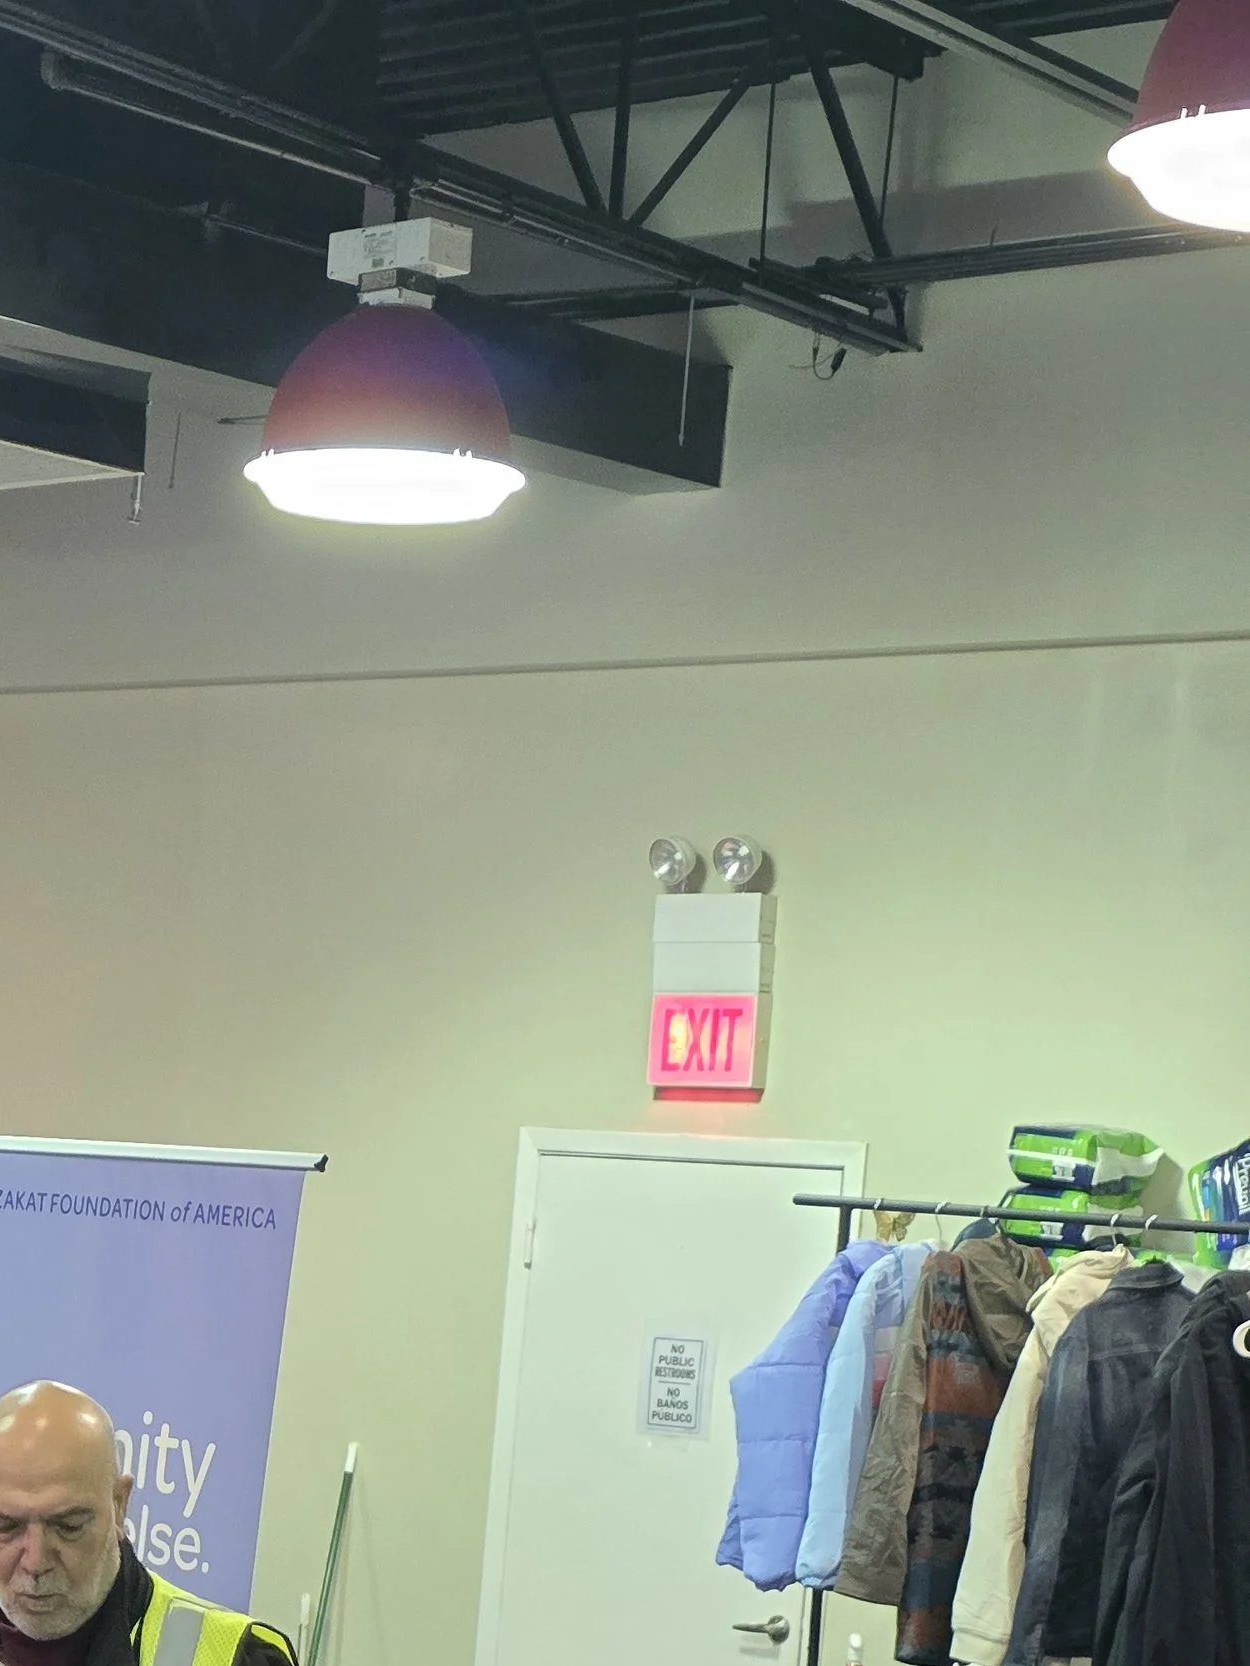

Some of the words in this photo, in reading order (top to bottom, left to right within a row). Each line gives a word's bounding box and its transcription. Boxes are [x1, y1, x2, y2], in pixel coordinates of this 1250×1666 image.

[661, 1008, 743, 1071] EXIT
[50, 1192, 166, 1222] FOUNDATION
[170, 1200, 192, 1223] of
[193, 1202, 276, 1230] AMERICA
[670, 1344, 685, 1354] NO
[658, 1354, 695, 1367] PUBLIC
[654, 1366, 696, 1380] RESTROOMS
[666, 1387, 681, 1397] NO
